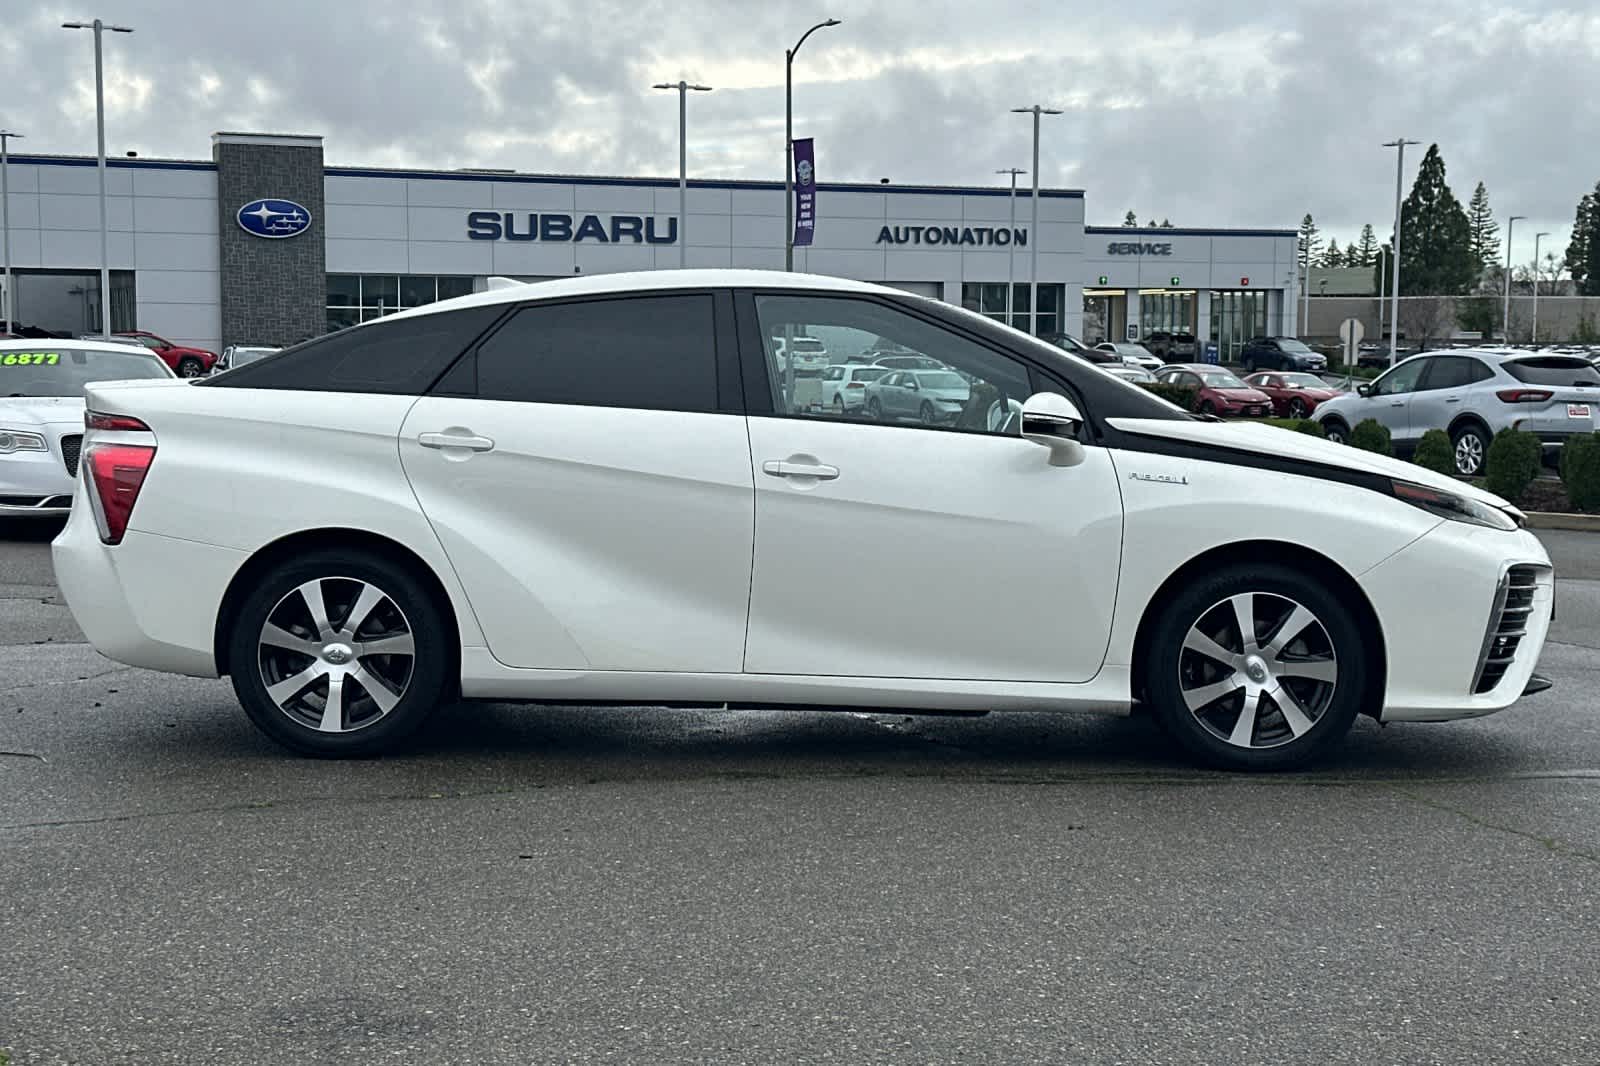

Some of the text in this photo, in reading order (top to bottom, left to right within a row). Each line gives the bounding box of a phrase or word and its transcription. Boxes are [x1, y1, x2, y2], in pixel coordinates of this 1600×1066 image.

[467, 212, 678, 244] SUBARU
[876, 225, 1028, 246] AUTONATION
[1107, 242, 1173, 256] SERVICE
[0, 352, 60, 366] 6877
